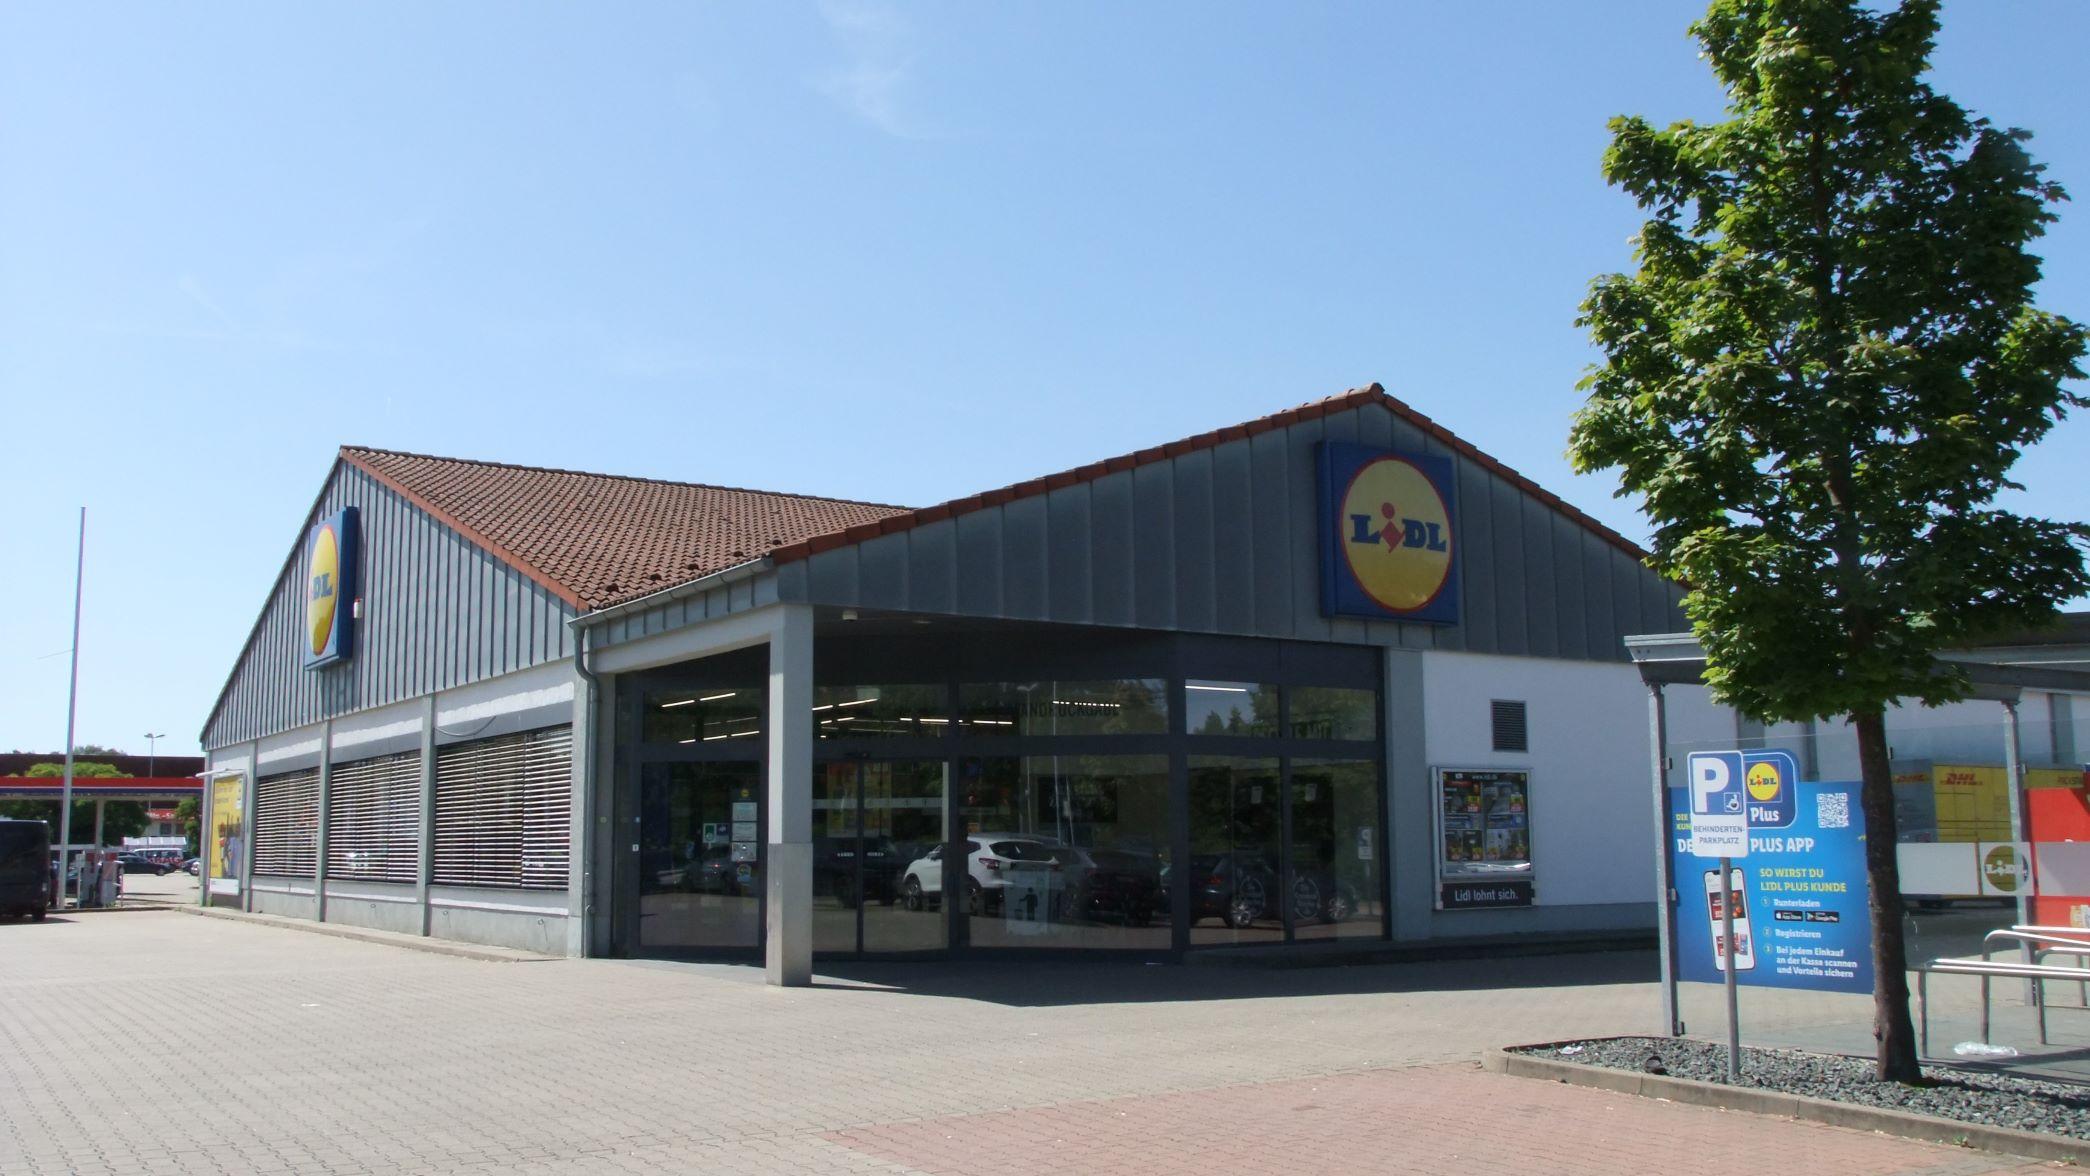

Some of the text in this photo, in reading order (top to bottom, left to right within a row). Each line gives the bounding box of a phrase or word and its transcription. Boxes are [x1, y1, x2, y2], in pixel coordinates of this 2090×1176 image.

[1350, 502, 1446, 554] LIDL
[312, 572, 332, 600] DL
[1692, 757, 1730, 812] P
[1749, 775, 1777, 788] LIDL
[1750, 806, 1780, 822] Plus
[1694, 825, 1745, 833] BEHINDERTEN-
[1699, 836, 1740, 844] PARKPLATZ
[1750, 838, 1783, 852] PLUS
[1786, 838, 1814, 852] APP
[1760, 868, 1824, 878] SO WIRST DU
[1760, 882, 1847, 892] LIDL PLUS KUNDE
[1454, 888, 1519, 901] Lidl lohnt sich.
[1774, 898, 1820, 908] Runterladen
[1774, 928, 1822, 938] Registrieren
[1776, 946, 1788, 954] Bei
[1789, 946, 1813, 956] jedem
[1814, 948, 1844, 957] Einkauf
[1802, 958, 1823, 966] Kasse
[1825, 960, 1858, 968] scannen
[1793, 967, 1824, 976] Vorteile
[1824, 968, 1854, 978] sichern
